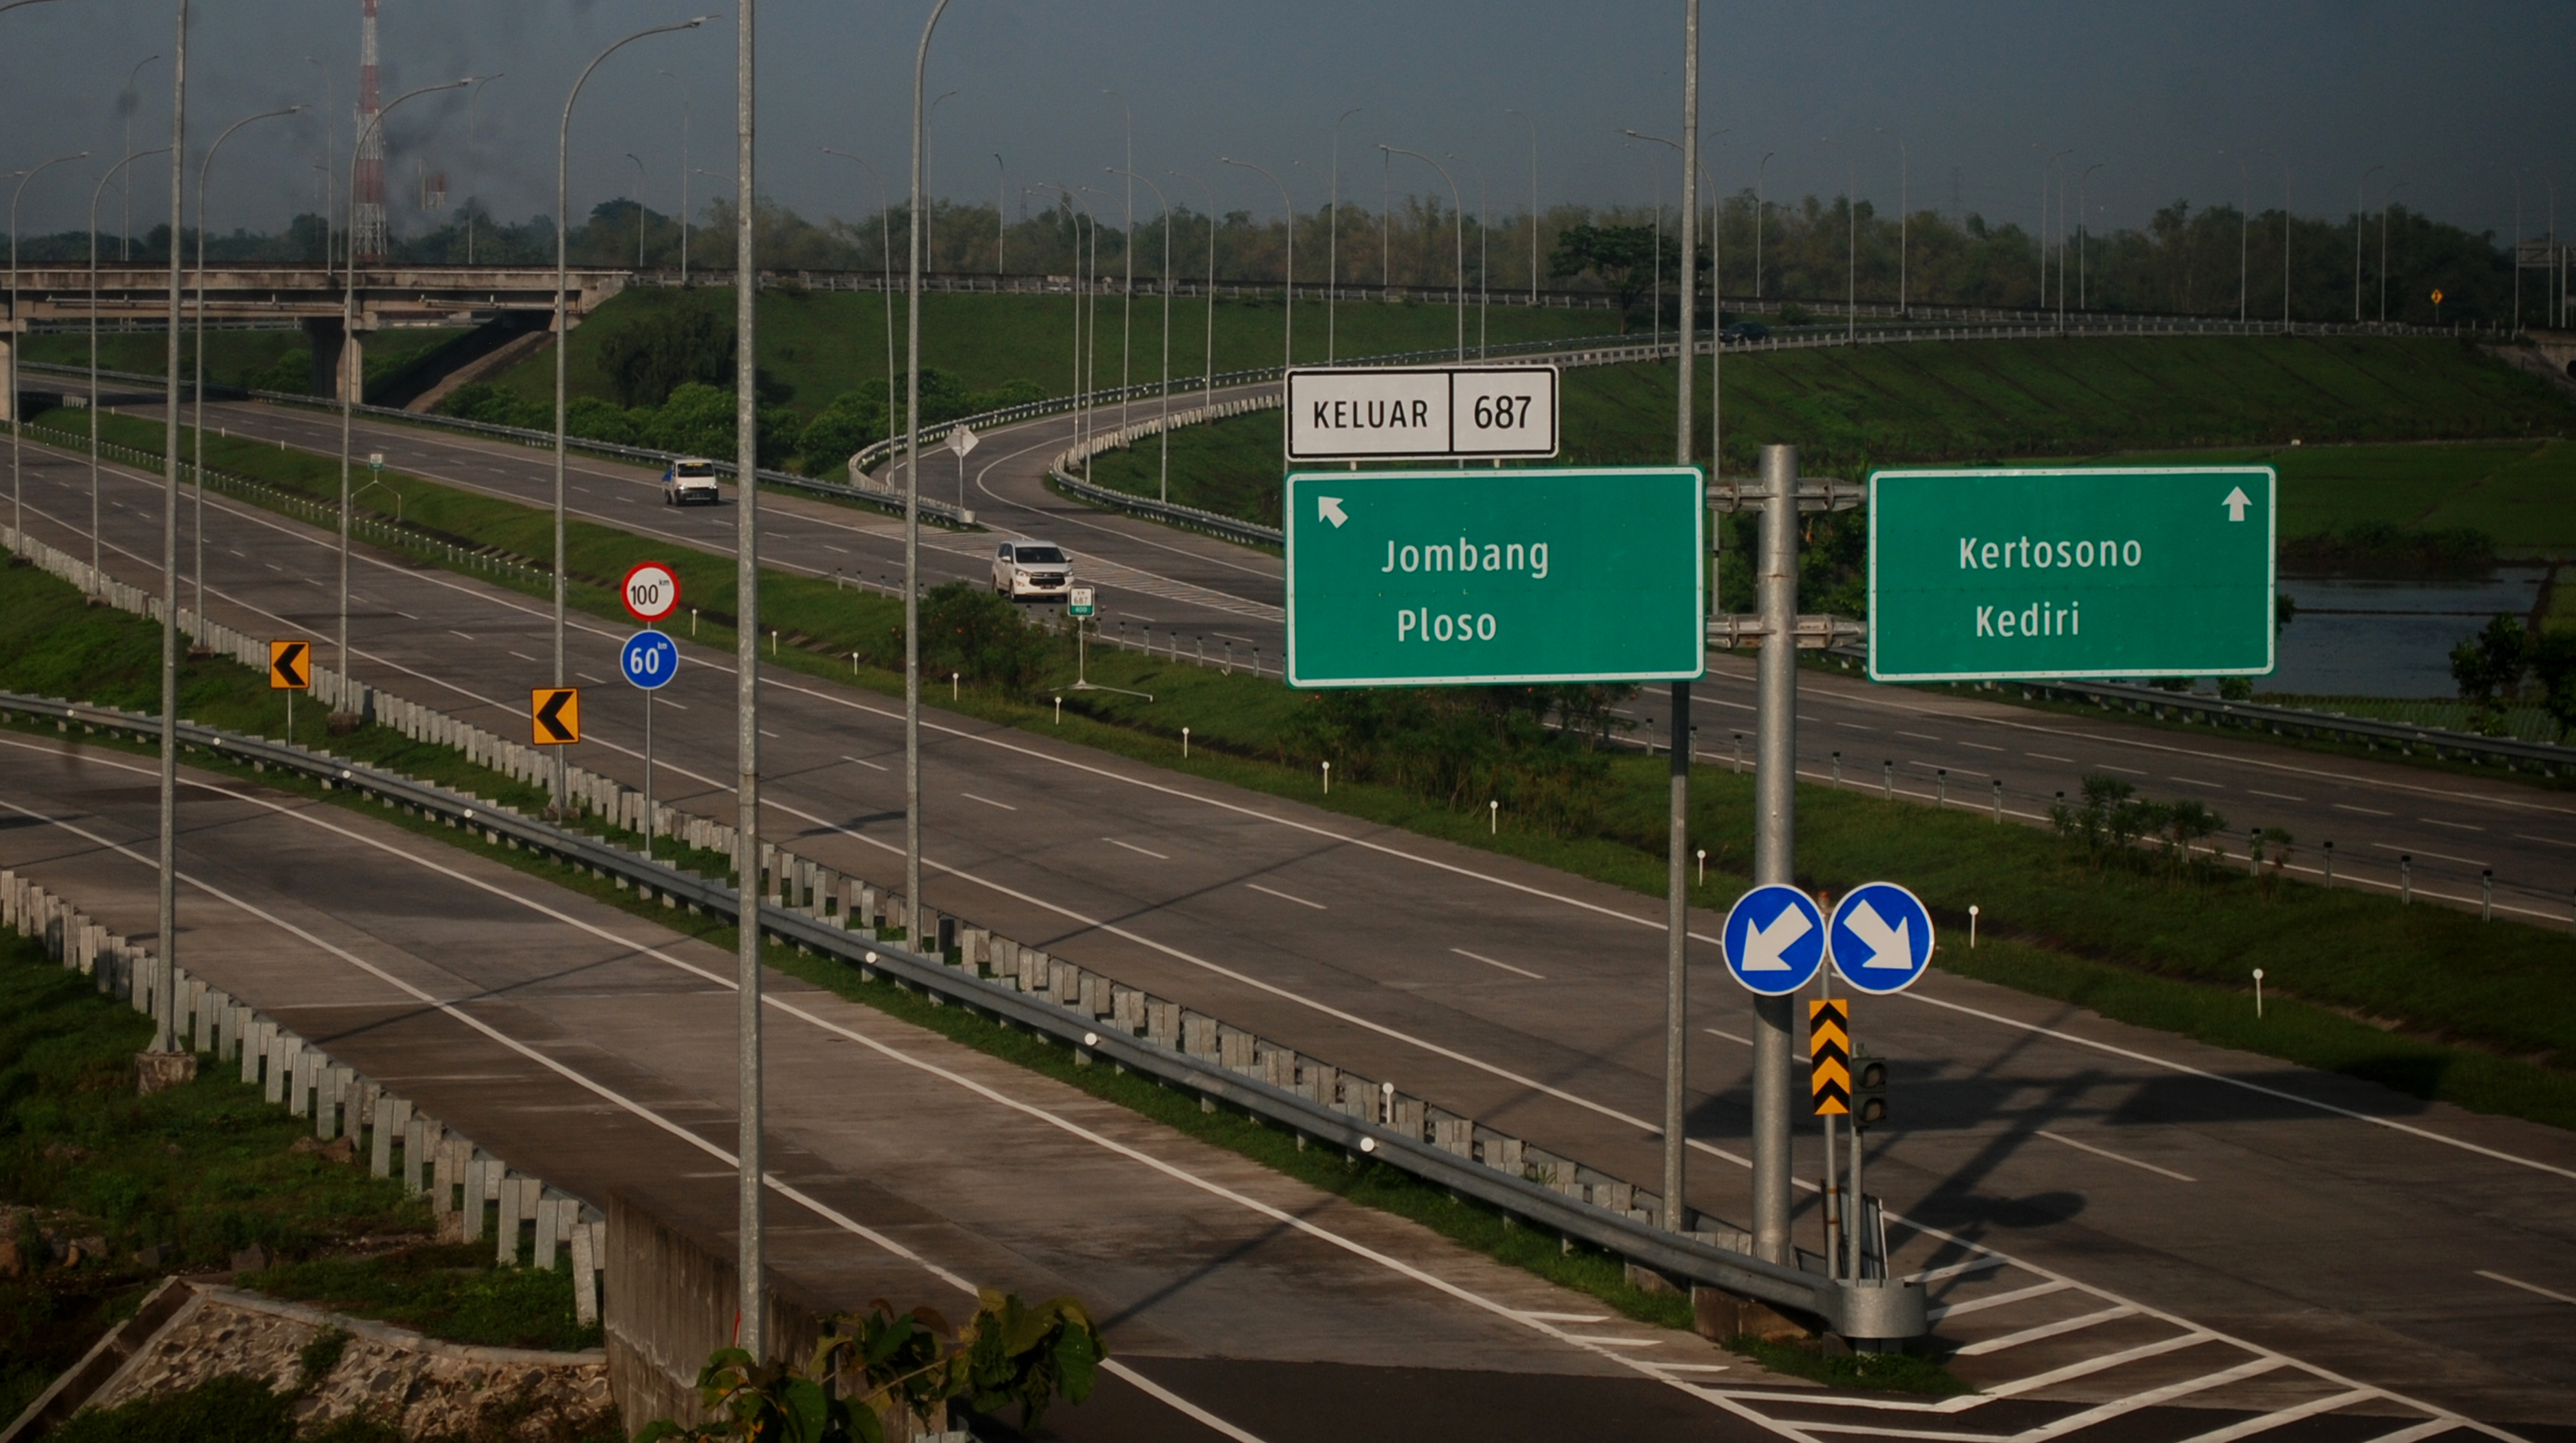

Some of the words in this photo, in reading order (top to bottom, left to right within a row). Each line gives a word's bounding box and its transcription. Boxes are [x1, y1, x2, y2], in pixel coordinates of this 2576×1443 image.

[1313, 400, 1428, 429] KELUAR
[1473, 396, 1531, 429] 687
[1381, 537, 1549, 578] Jombang
[1960, 536, 2142, 569] Kertosono
[630, 584, 658, 605] 100
[1397, 607, 1497, 641] Ploso
[1976, 601, 2079, 637] Kediri
[630, 647, 659, 674] 60
